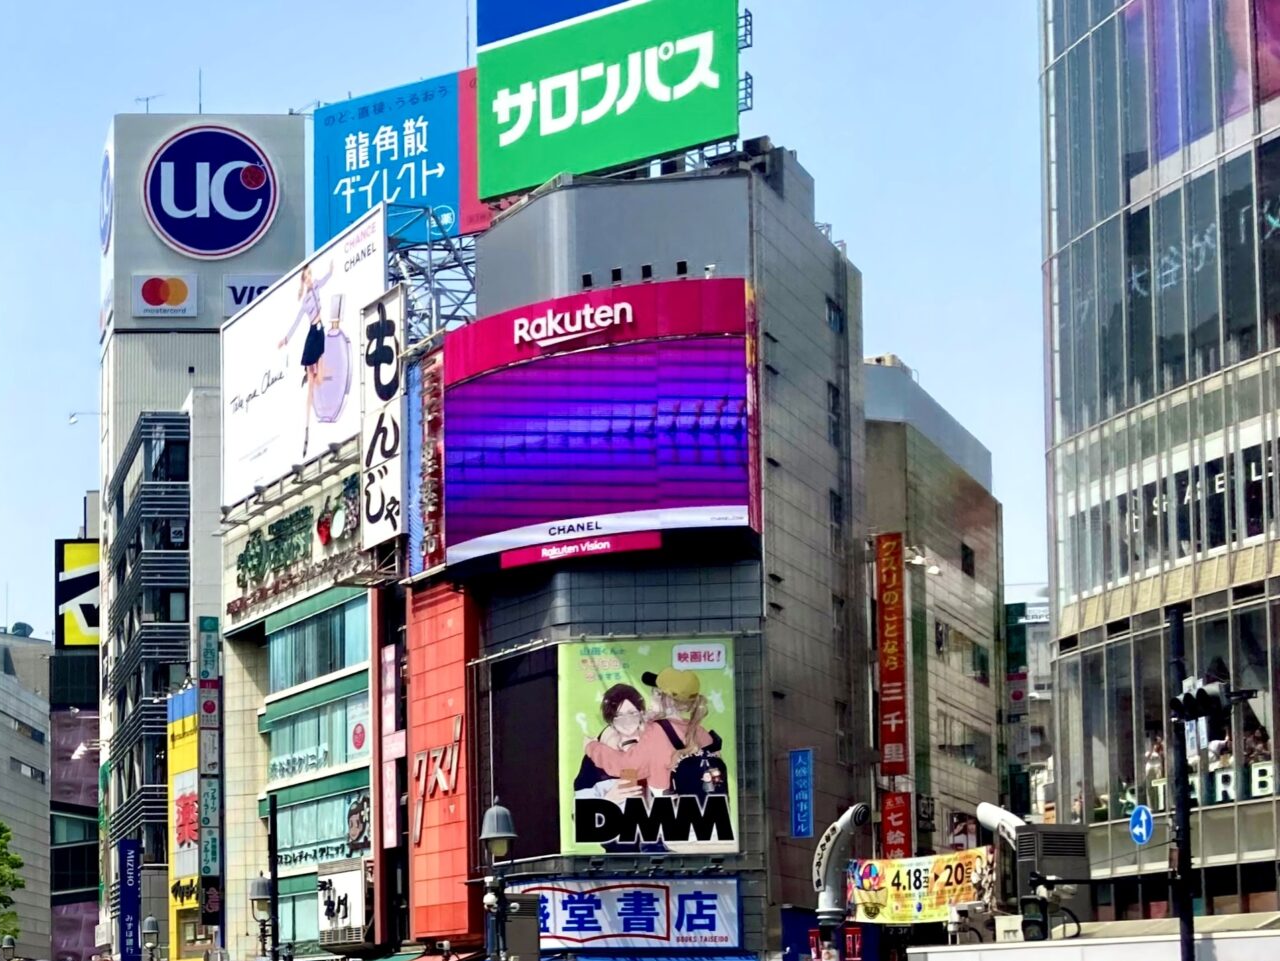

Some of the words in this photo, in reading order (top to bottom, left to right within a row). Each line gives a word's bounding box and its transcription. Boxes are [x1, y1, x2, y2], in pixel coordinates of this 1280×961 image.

[492, 31, 719, 147] サロンパス
[344, 114, 430, 170] 龍角散
[332, 161, 445, 213] ダイレクト
[343, 244, 377, 272] CHANEL
[513, 301, 633, 347] Rakuten
[365, 302, 401, 532] もんじゃ
[541, 544, 579, 559] Rakuten
[580, 540, 611, 552] Vision
[548, 520, 603, 536] CHANEL
[881, 681, 905, 763] 三千里
[574, 794, 735, 843] DMM
[127, 849, 135, 886] MIZUHO
[891, 868, 922, 891] 4.18
[944, 862, 965, 886] 20
